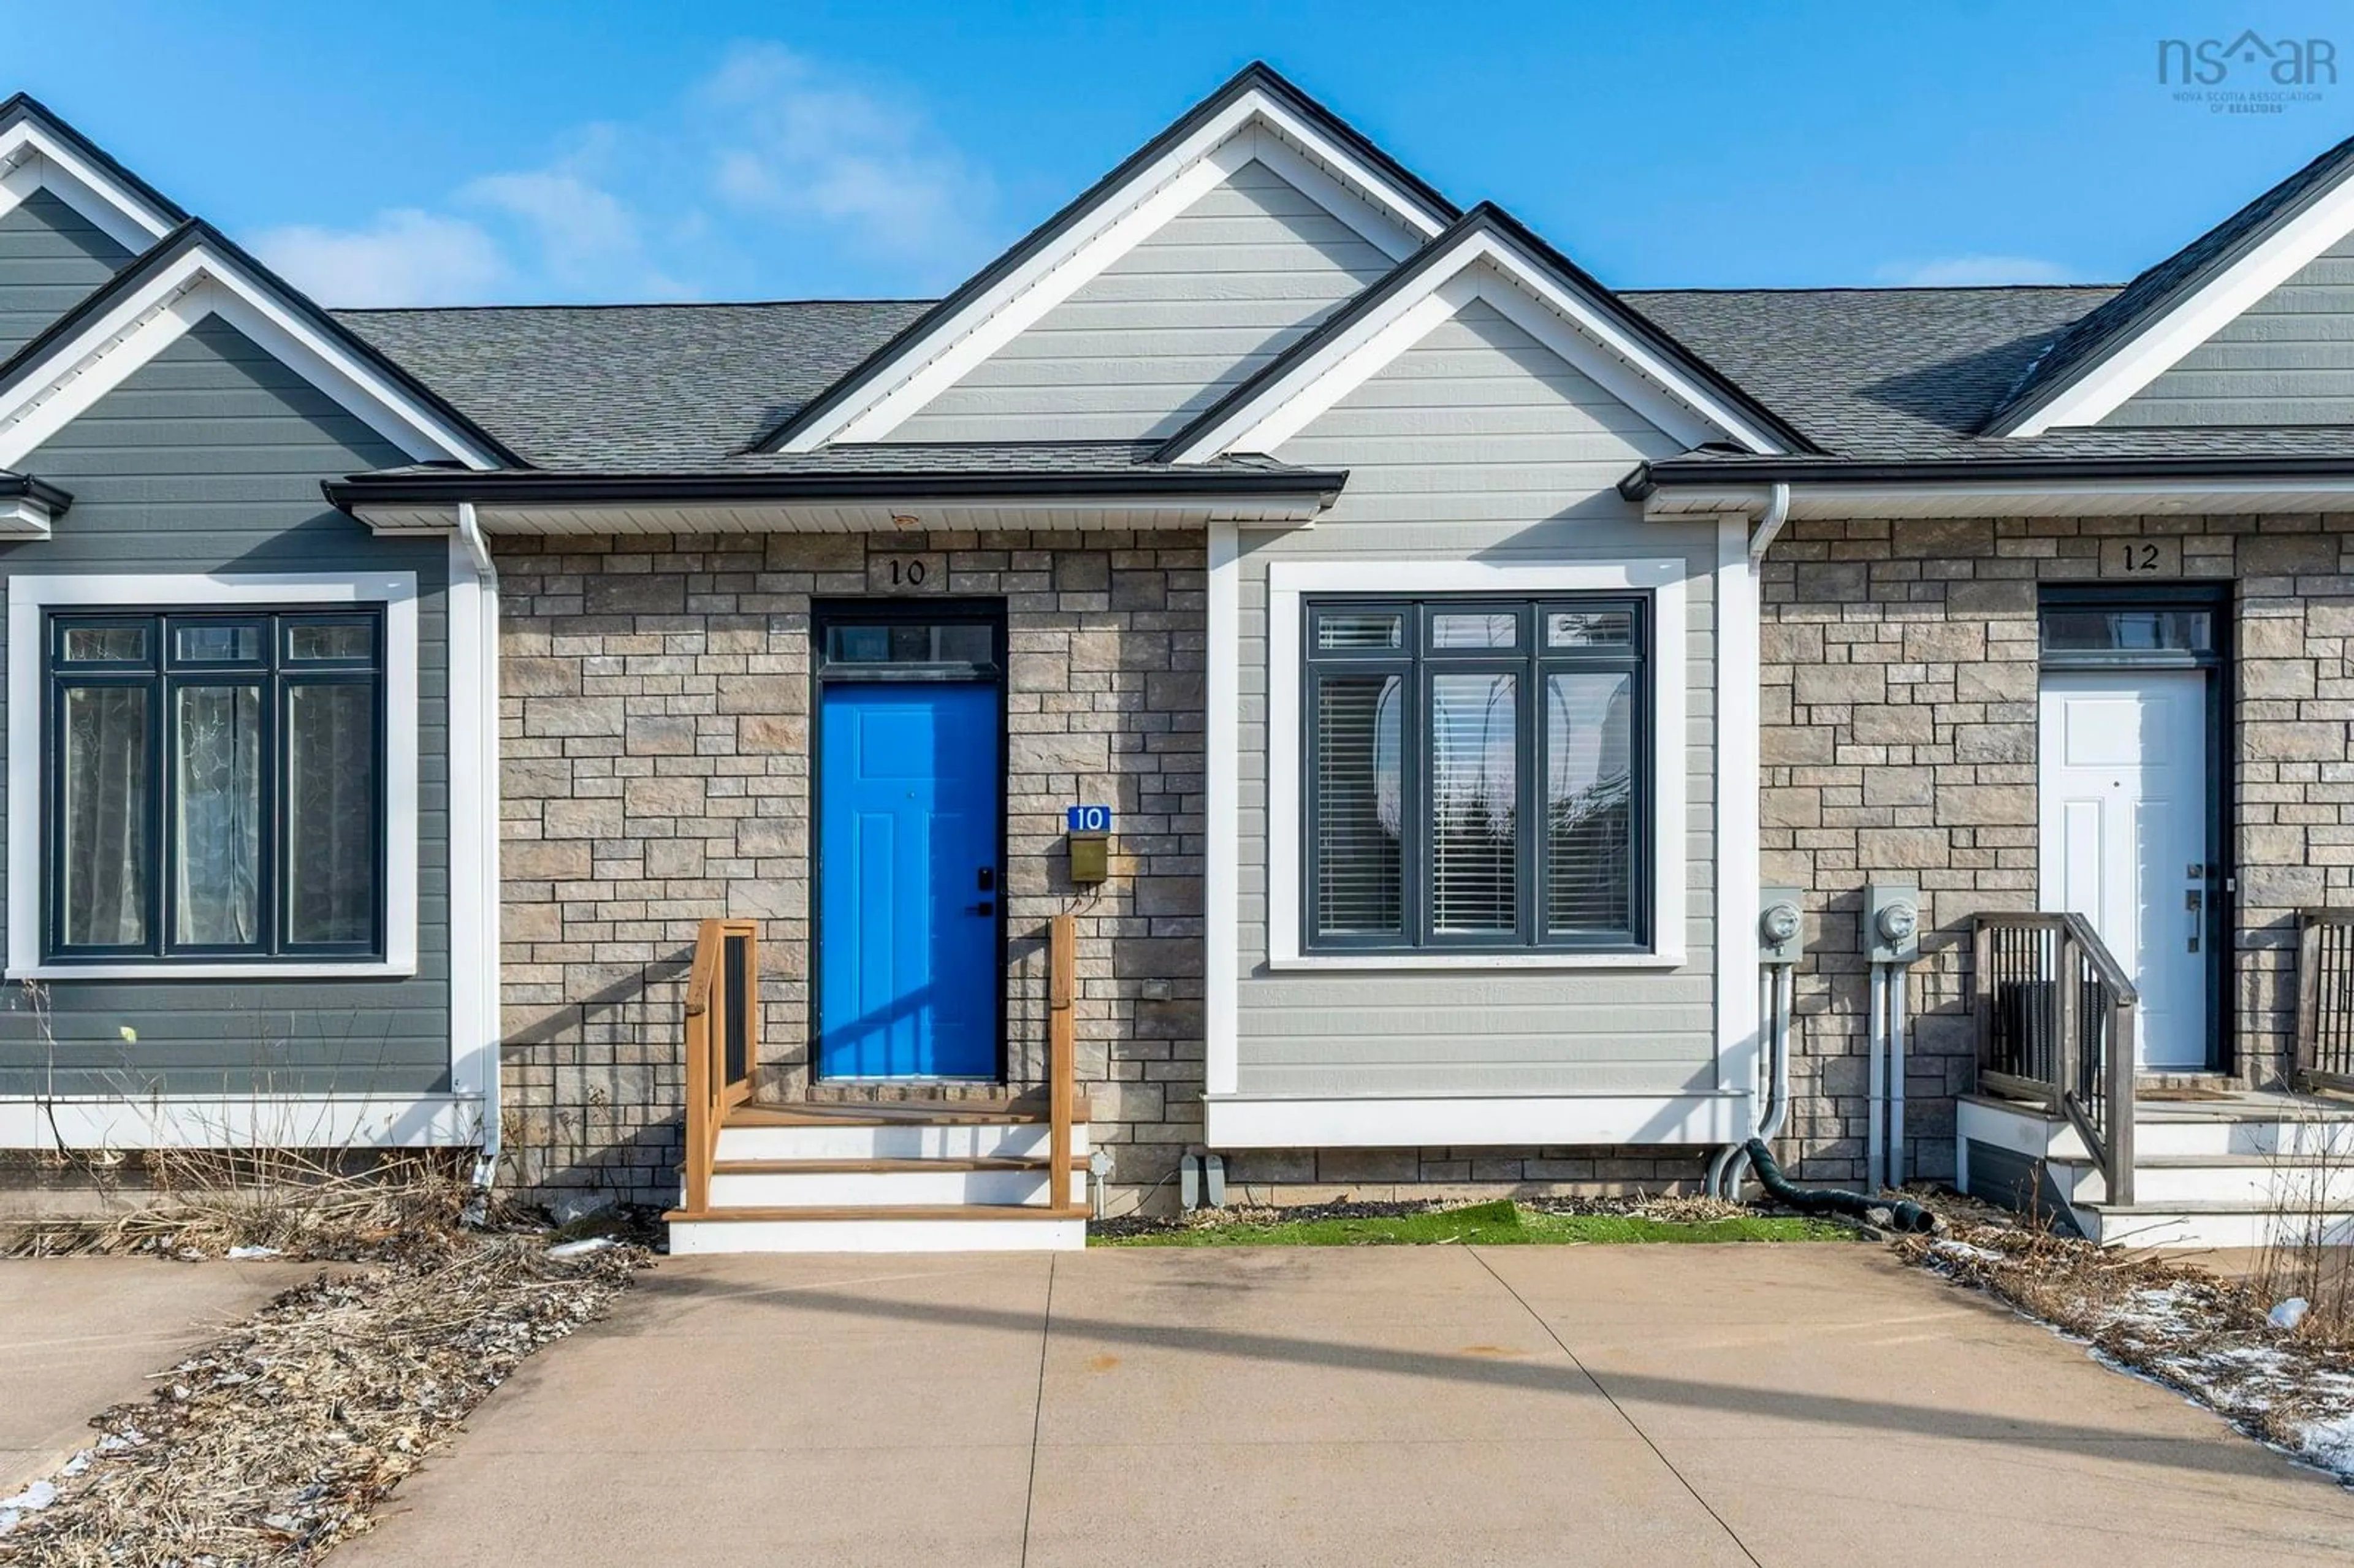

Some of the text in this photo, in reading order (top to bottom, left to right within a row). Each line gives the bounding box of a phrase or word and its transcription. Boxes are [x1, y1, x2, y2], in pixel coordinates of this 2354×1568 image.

[2123, 544, 2158, 571] 12
[889, 560, 925, 585] 10
[1077, 808, 1103, 831] 10
